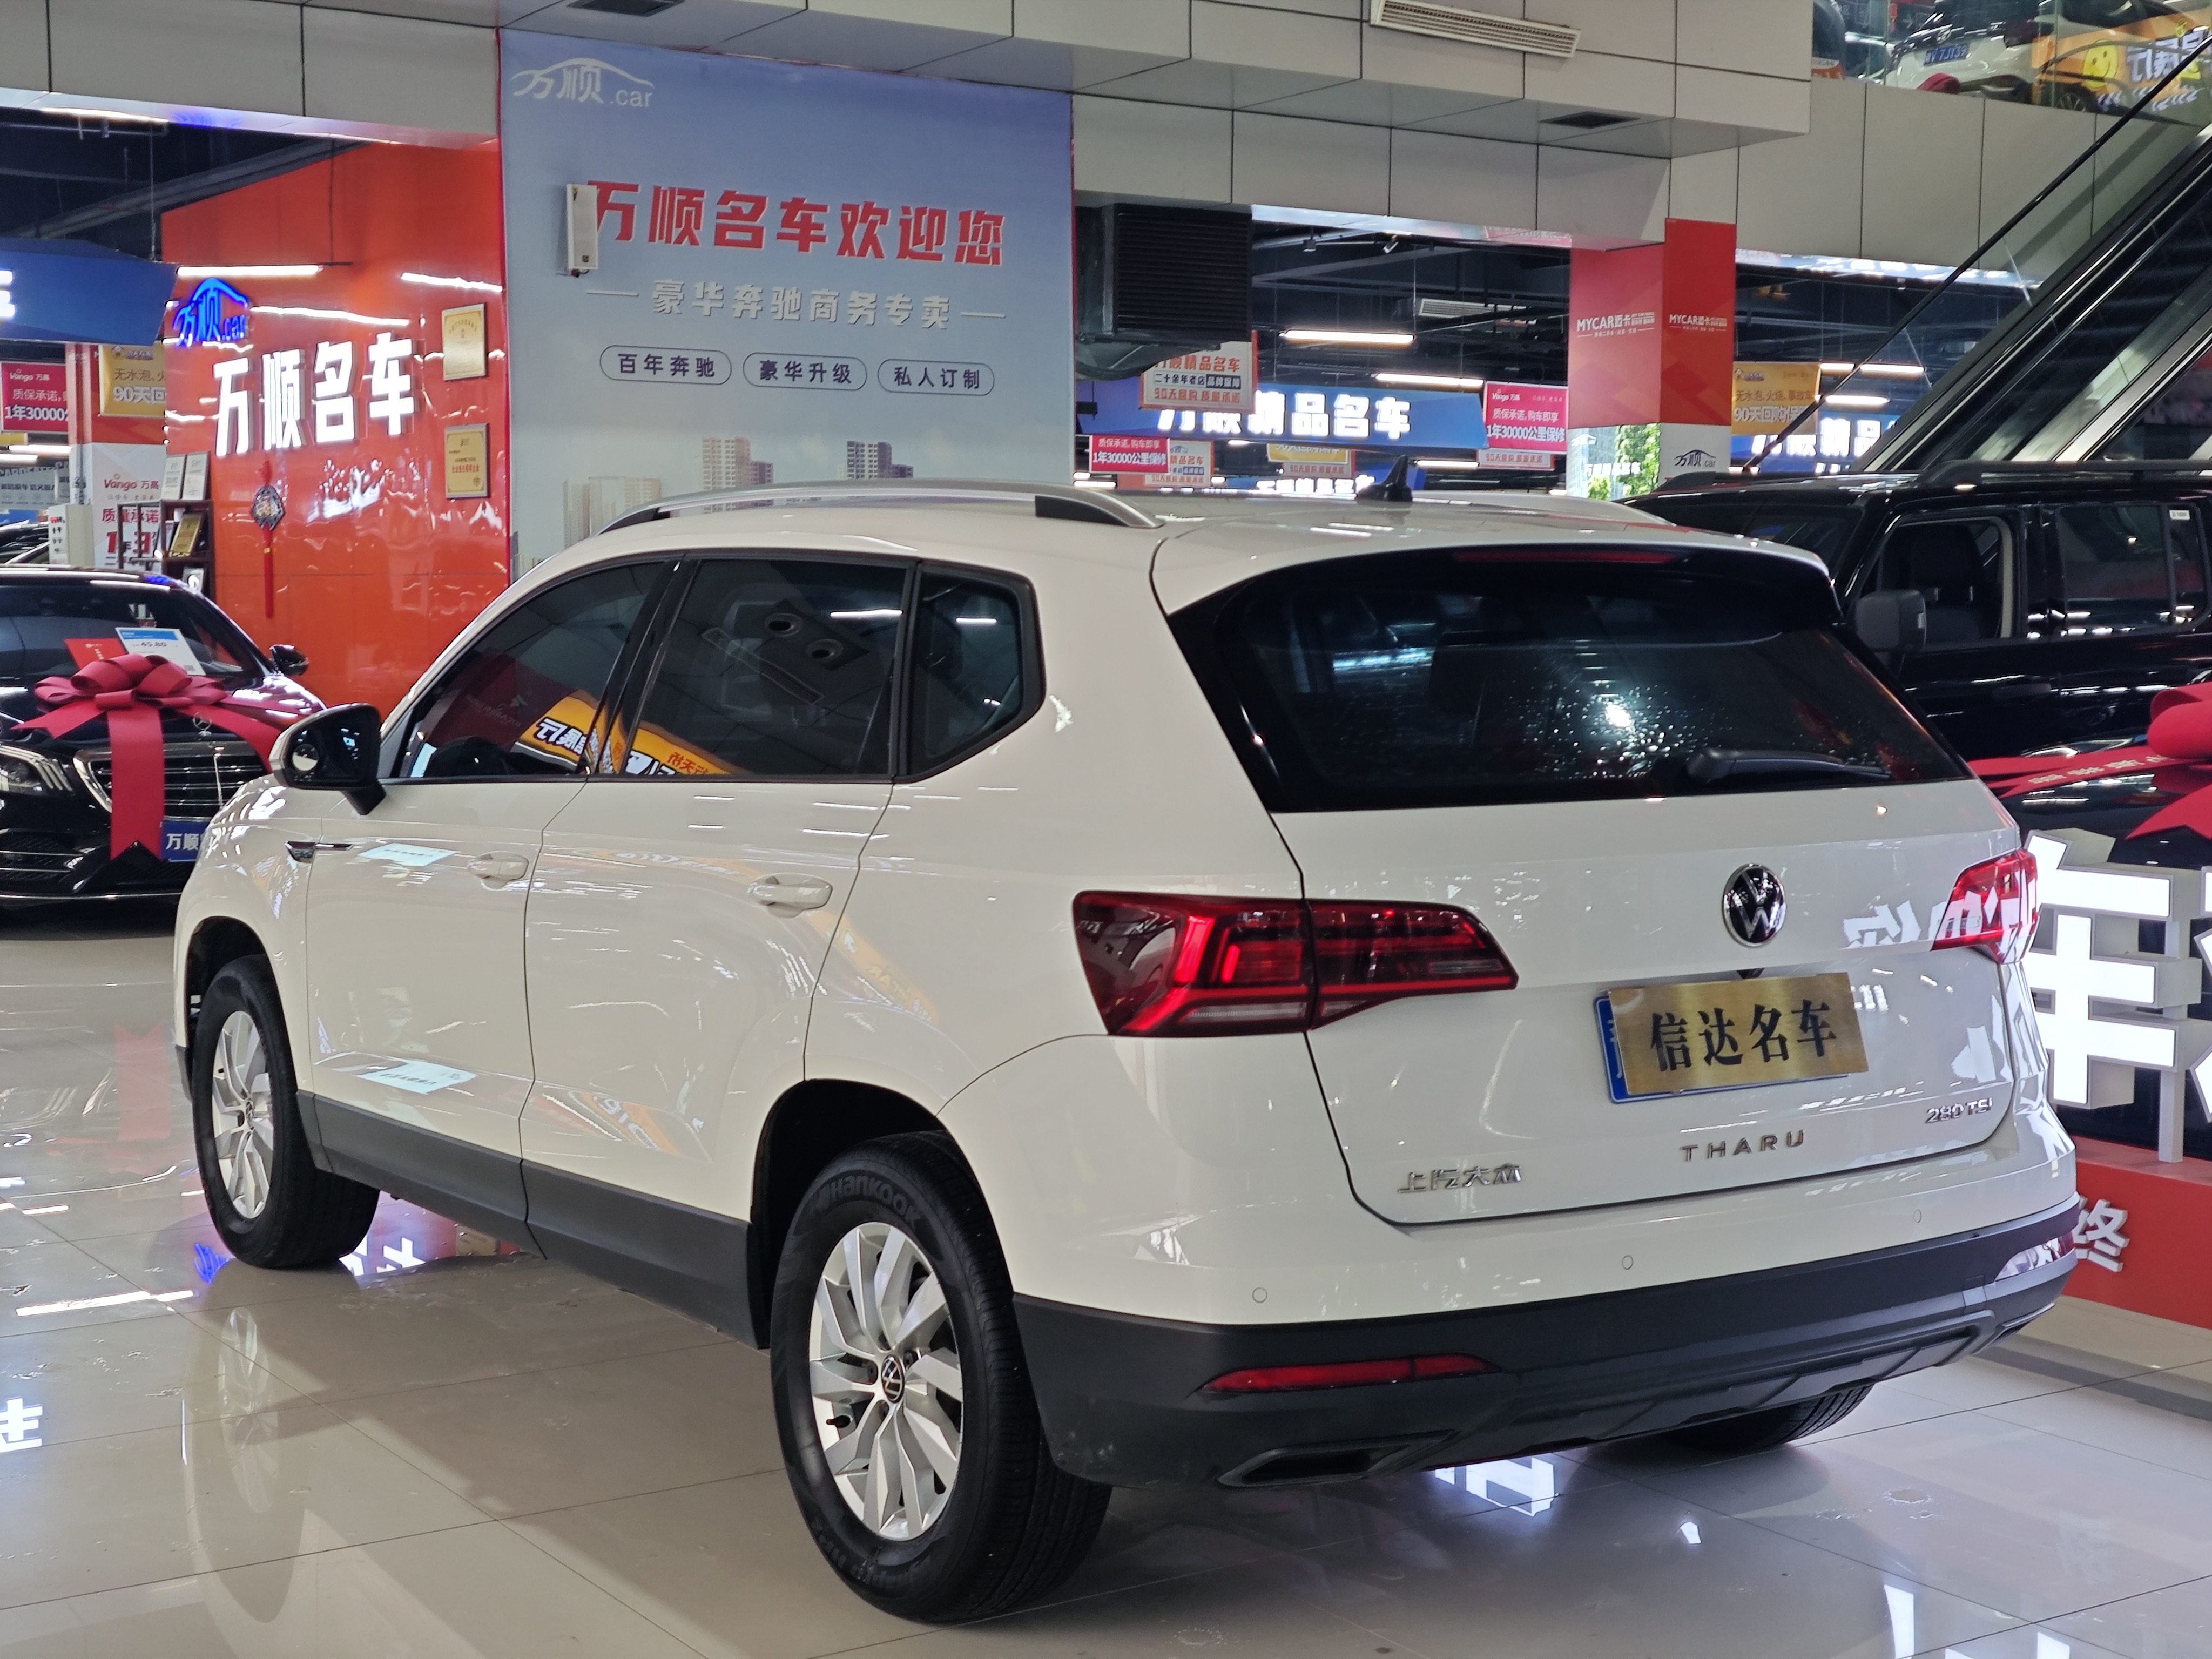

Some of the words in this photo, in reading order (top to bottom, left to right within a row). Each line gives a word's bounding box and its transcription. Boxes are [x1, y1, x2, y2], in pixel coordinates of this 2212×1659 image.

[588, 180, 1004, 266] 万顺名车欢迎您
[652, 280, 950, 329] 豪华奔驰商务专卖
[618, 353, 717, 379] 百年奔驰
[759, 359, 853, 385] 豪华升级
[893, 366, 980, 390] 私人订制
[213, 331, 416, 456] 万顺名车
[4, 404, 68, 421] 1年30000
[1486, 423, 1566, 443] 1年30000公里保修
[1093, 451, 1167, 466] 1年30000公里保修
[165, 833, 203, 851] 万顺
[1651, 1000, 1838, 1073] 信达名车
[1926, 1105, 1964, 1124] 280
[1967, 1097, 1993, 1115] TSI
[1680, 1130, 1806, 1163] THARU
[1398, 1163, 1522, 1193] 上汽大众
